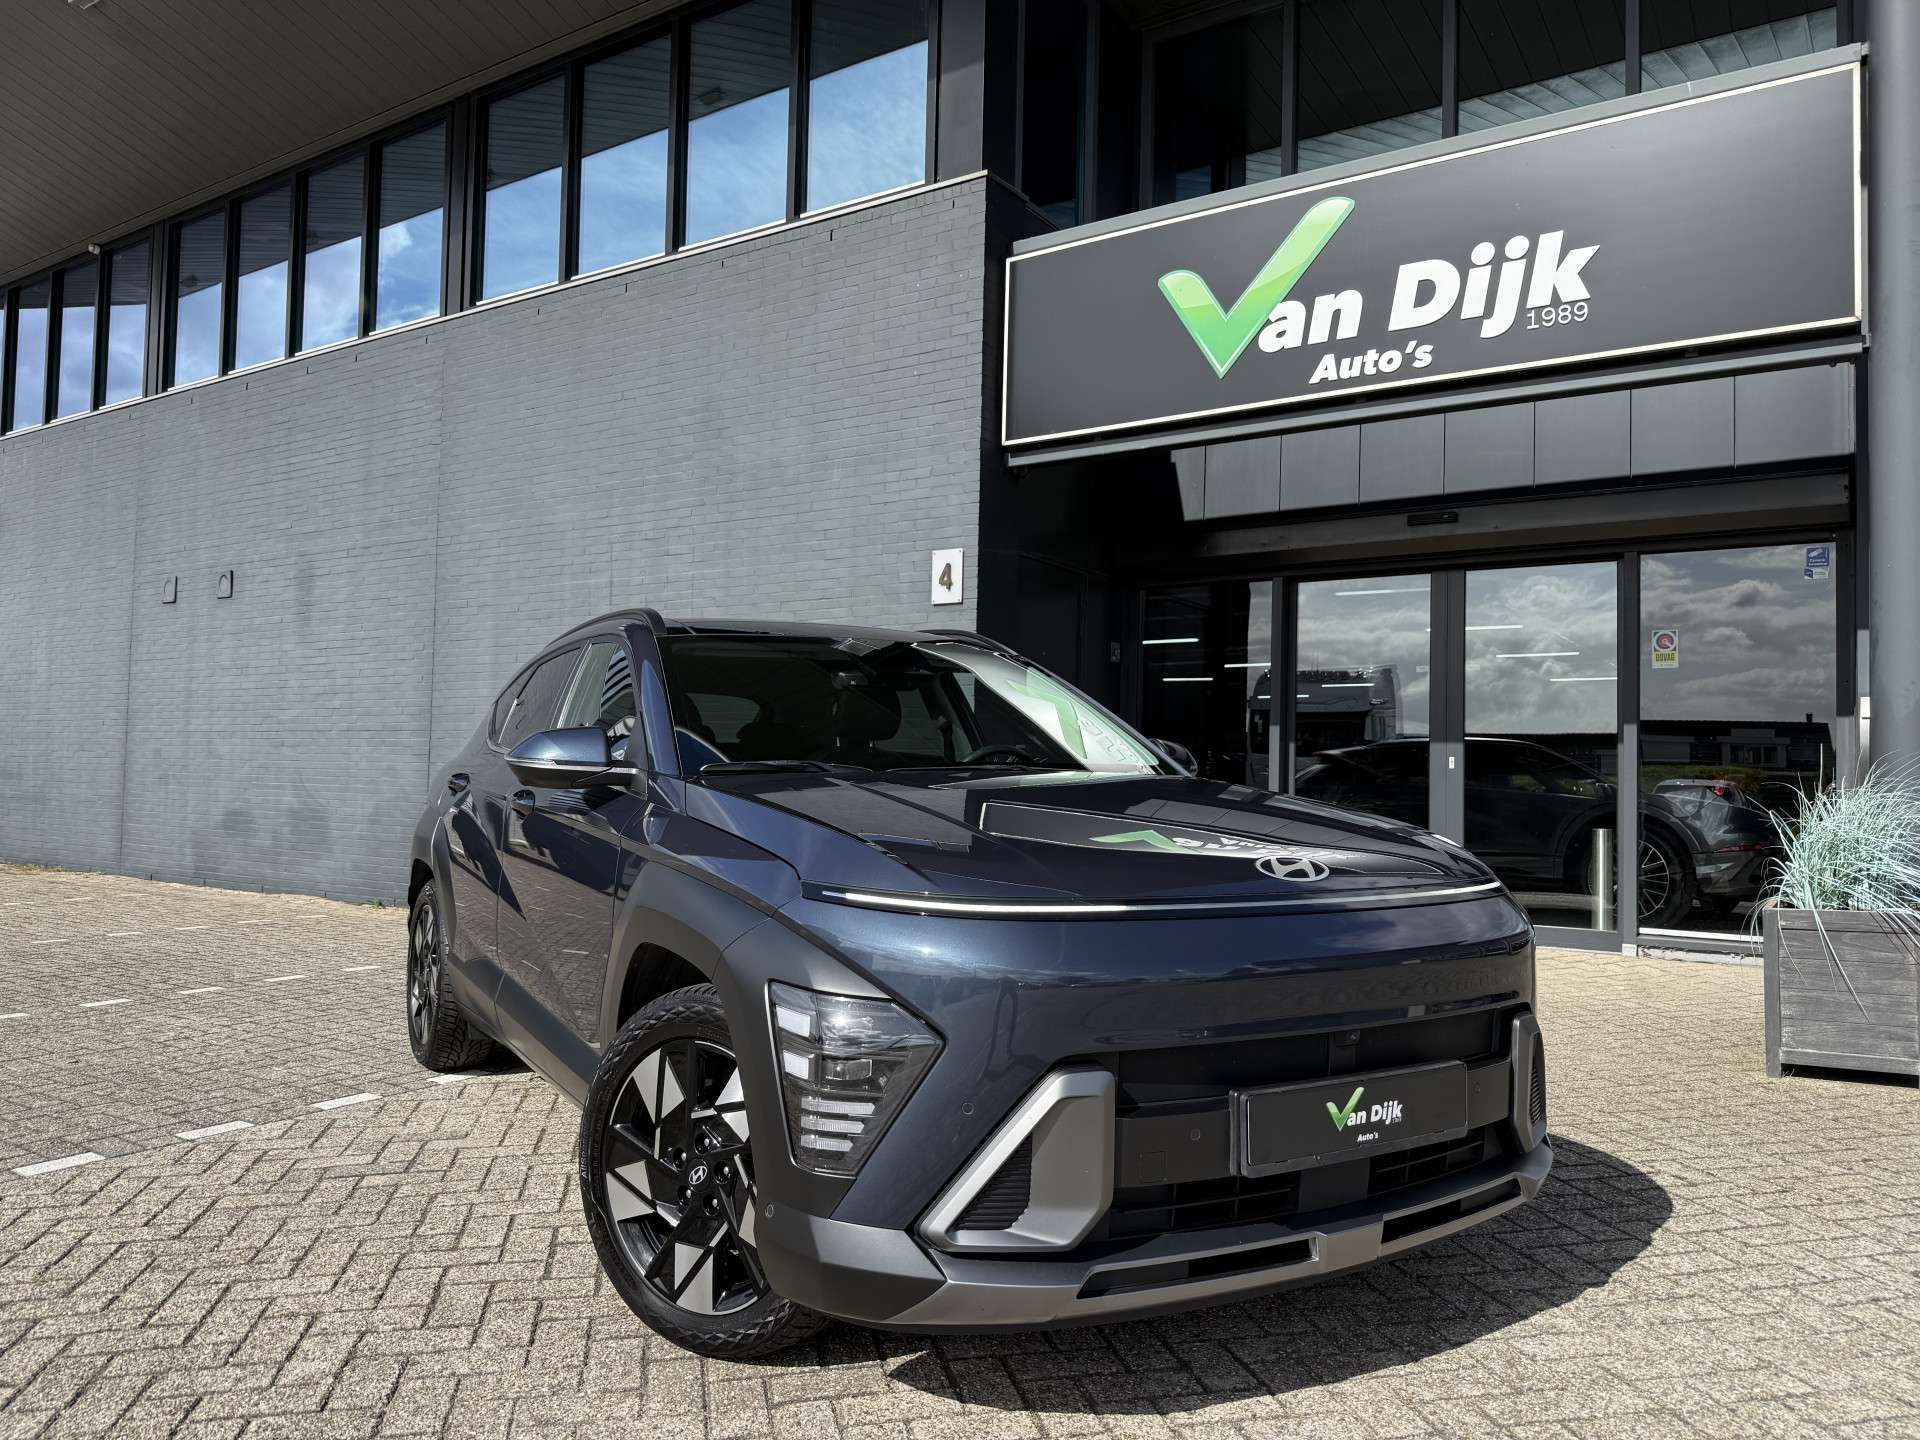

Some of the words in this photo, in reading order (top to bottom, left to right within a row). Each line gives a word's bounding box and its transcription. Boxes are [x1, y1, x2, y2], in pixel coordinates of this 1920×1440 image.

[1157, 196, 1364, 379] Van
[1388, 230, 1600, 338] Dijk
[1525, 303, 1588, 330] 1989
[1308, 340, 1434, 385] Auto's
[938, 562, 953, 592] 4
[1370, 1100, 1403, 1125] Dijk
[1357, 1132, 1379, 1142] Auto's
